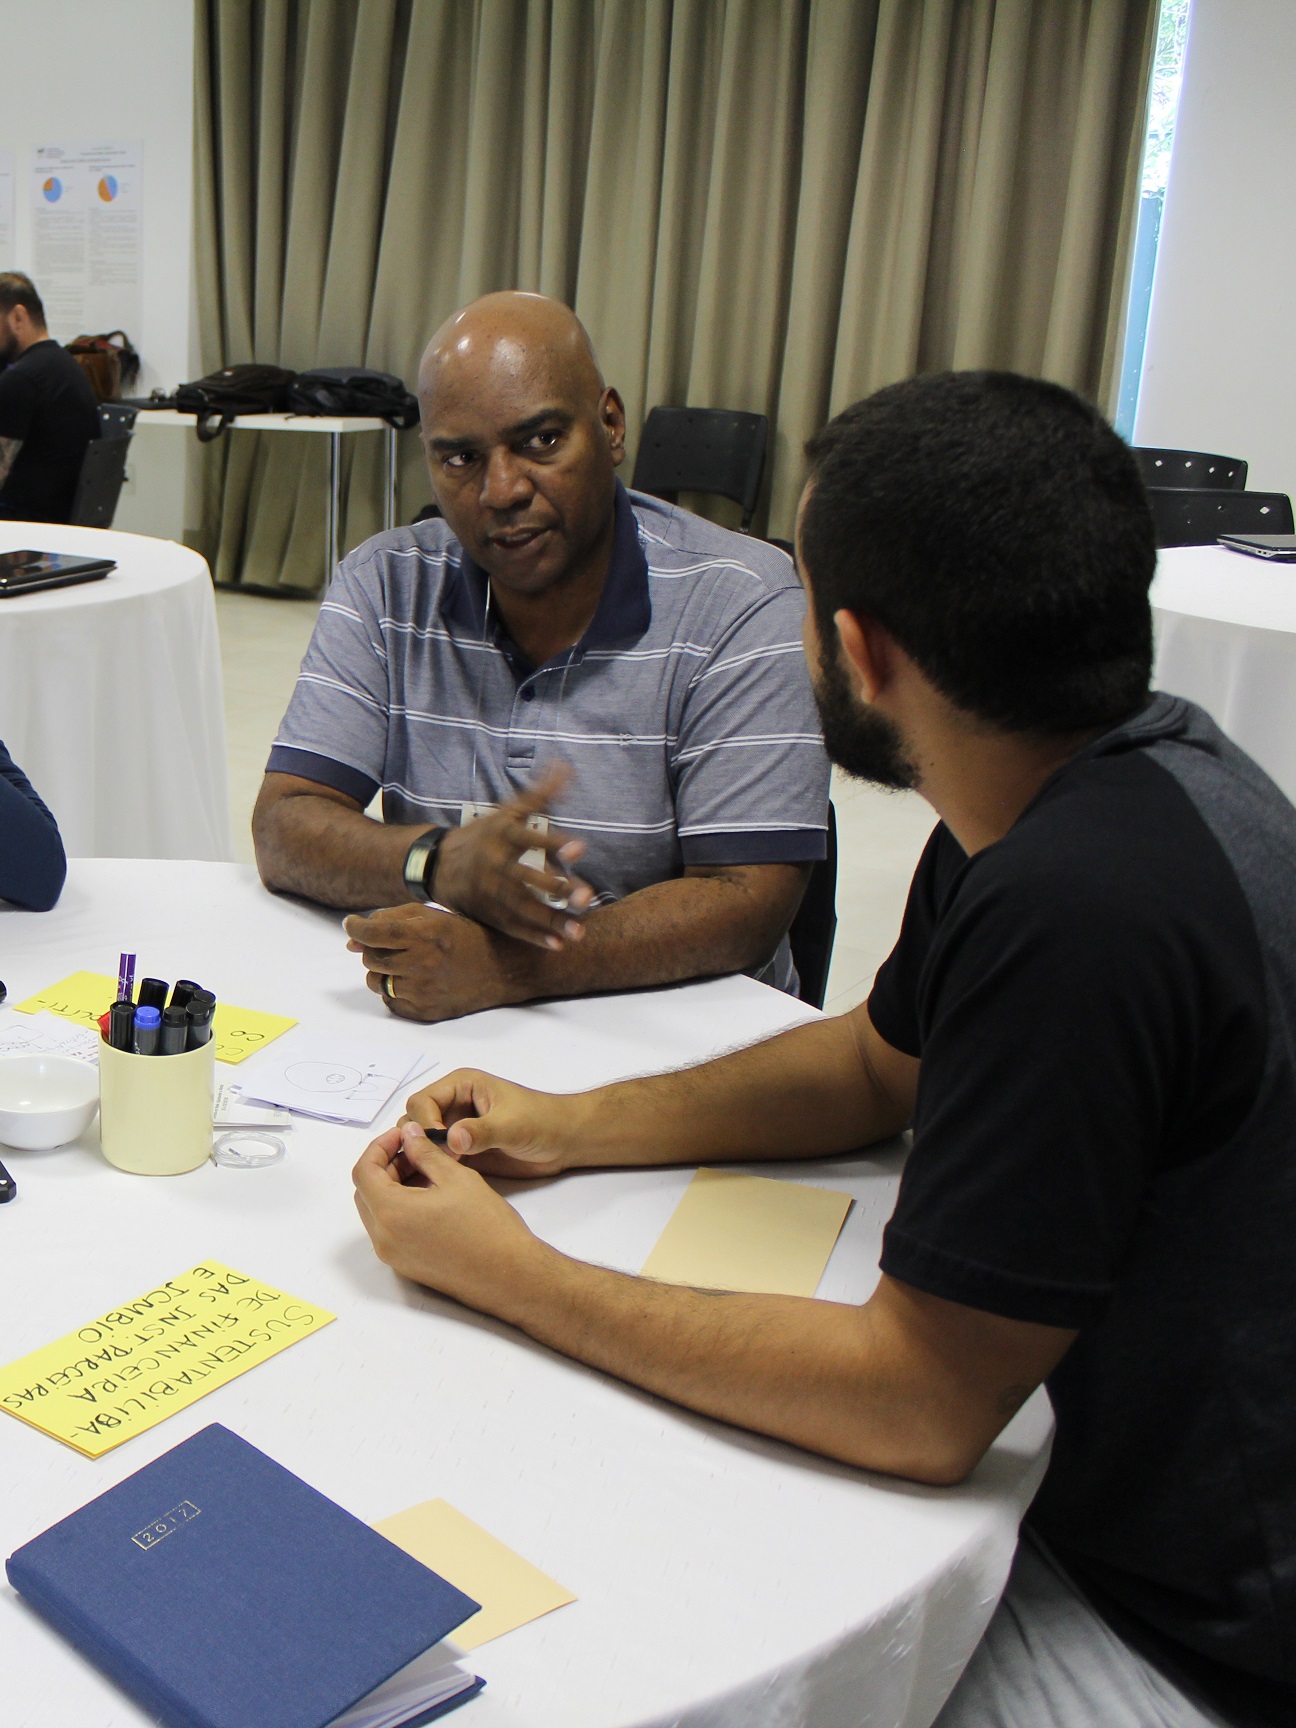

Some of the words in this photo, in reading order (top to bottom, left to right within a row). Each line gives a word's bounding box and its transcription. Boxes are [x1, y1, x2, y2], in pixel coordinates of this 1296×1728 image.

[192, 1267, 216, 1280] E
[198, 1272, 250, 1303] DAS
[236, 1289, 281, 1312] DE
[67, 1312, 240, 1403] FINANCEIRA
[3, 1343, 134, 1409] PARCEIRAS
[143, 1508, 187, 1542] 2017
